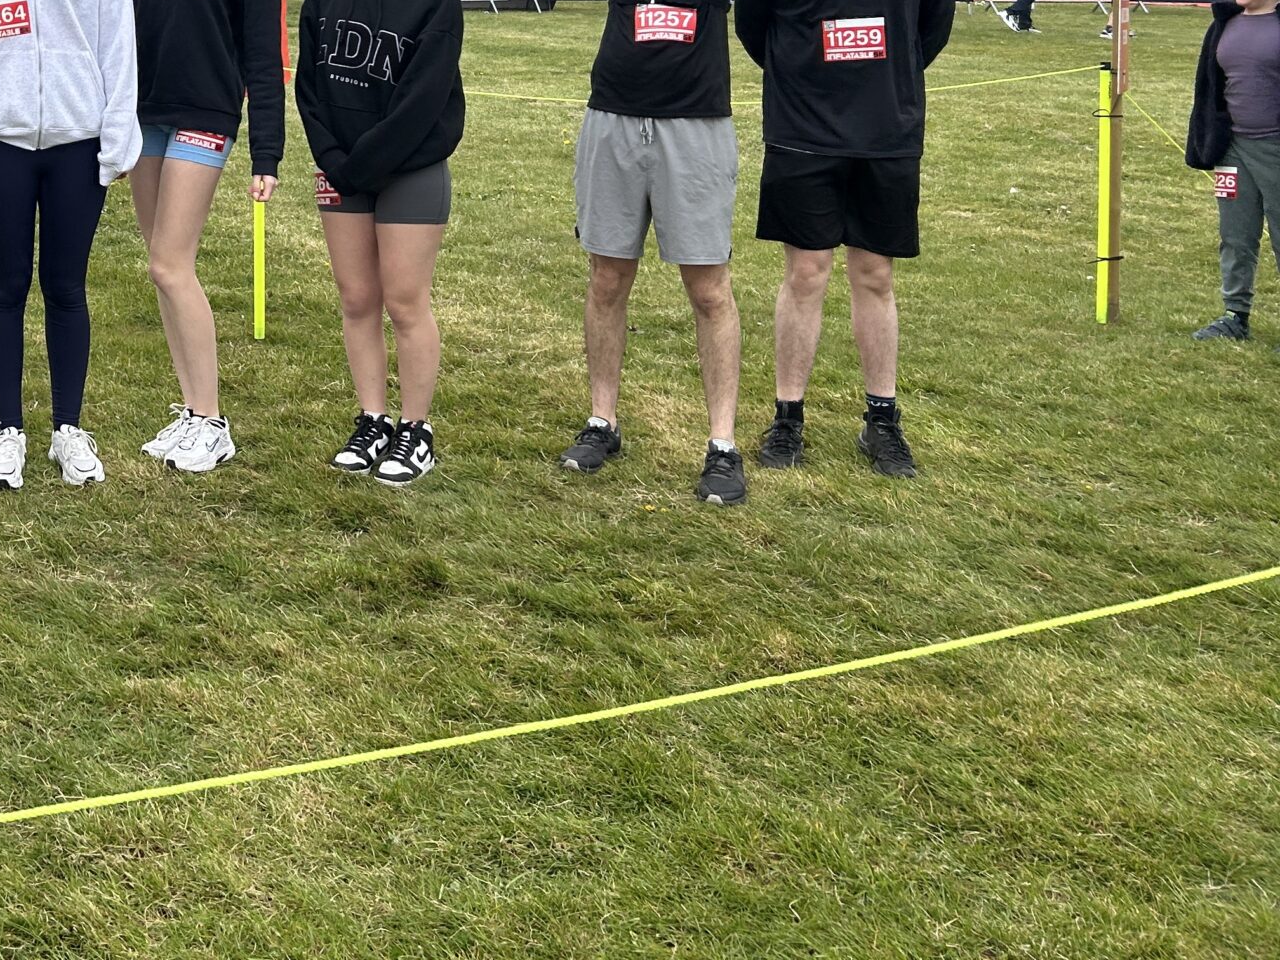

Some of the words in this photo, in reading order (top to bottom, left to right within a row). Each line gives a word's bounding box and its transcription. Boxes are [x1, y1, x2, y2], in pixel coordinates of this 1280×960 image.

[638, 11, 694, 27] 11257
[826, 29, 882, 47] 11259
[330, 73, 358, 85] STUDIO
